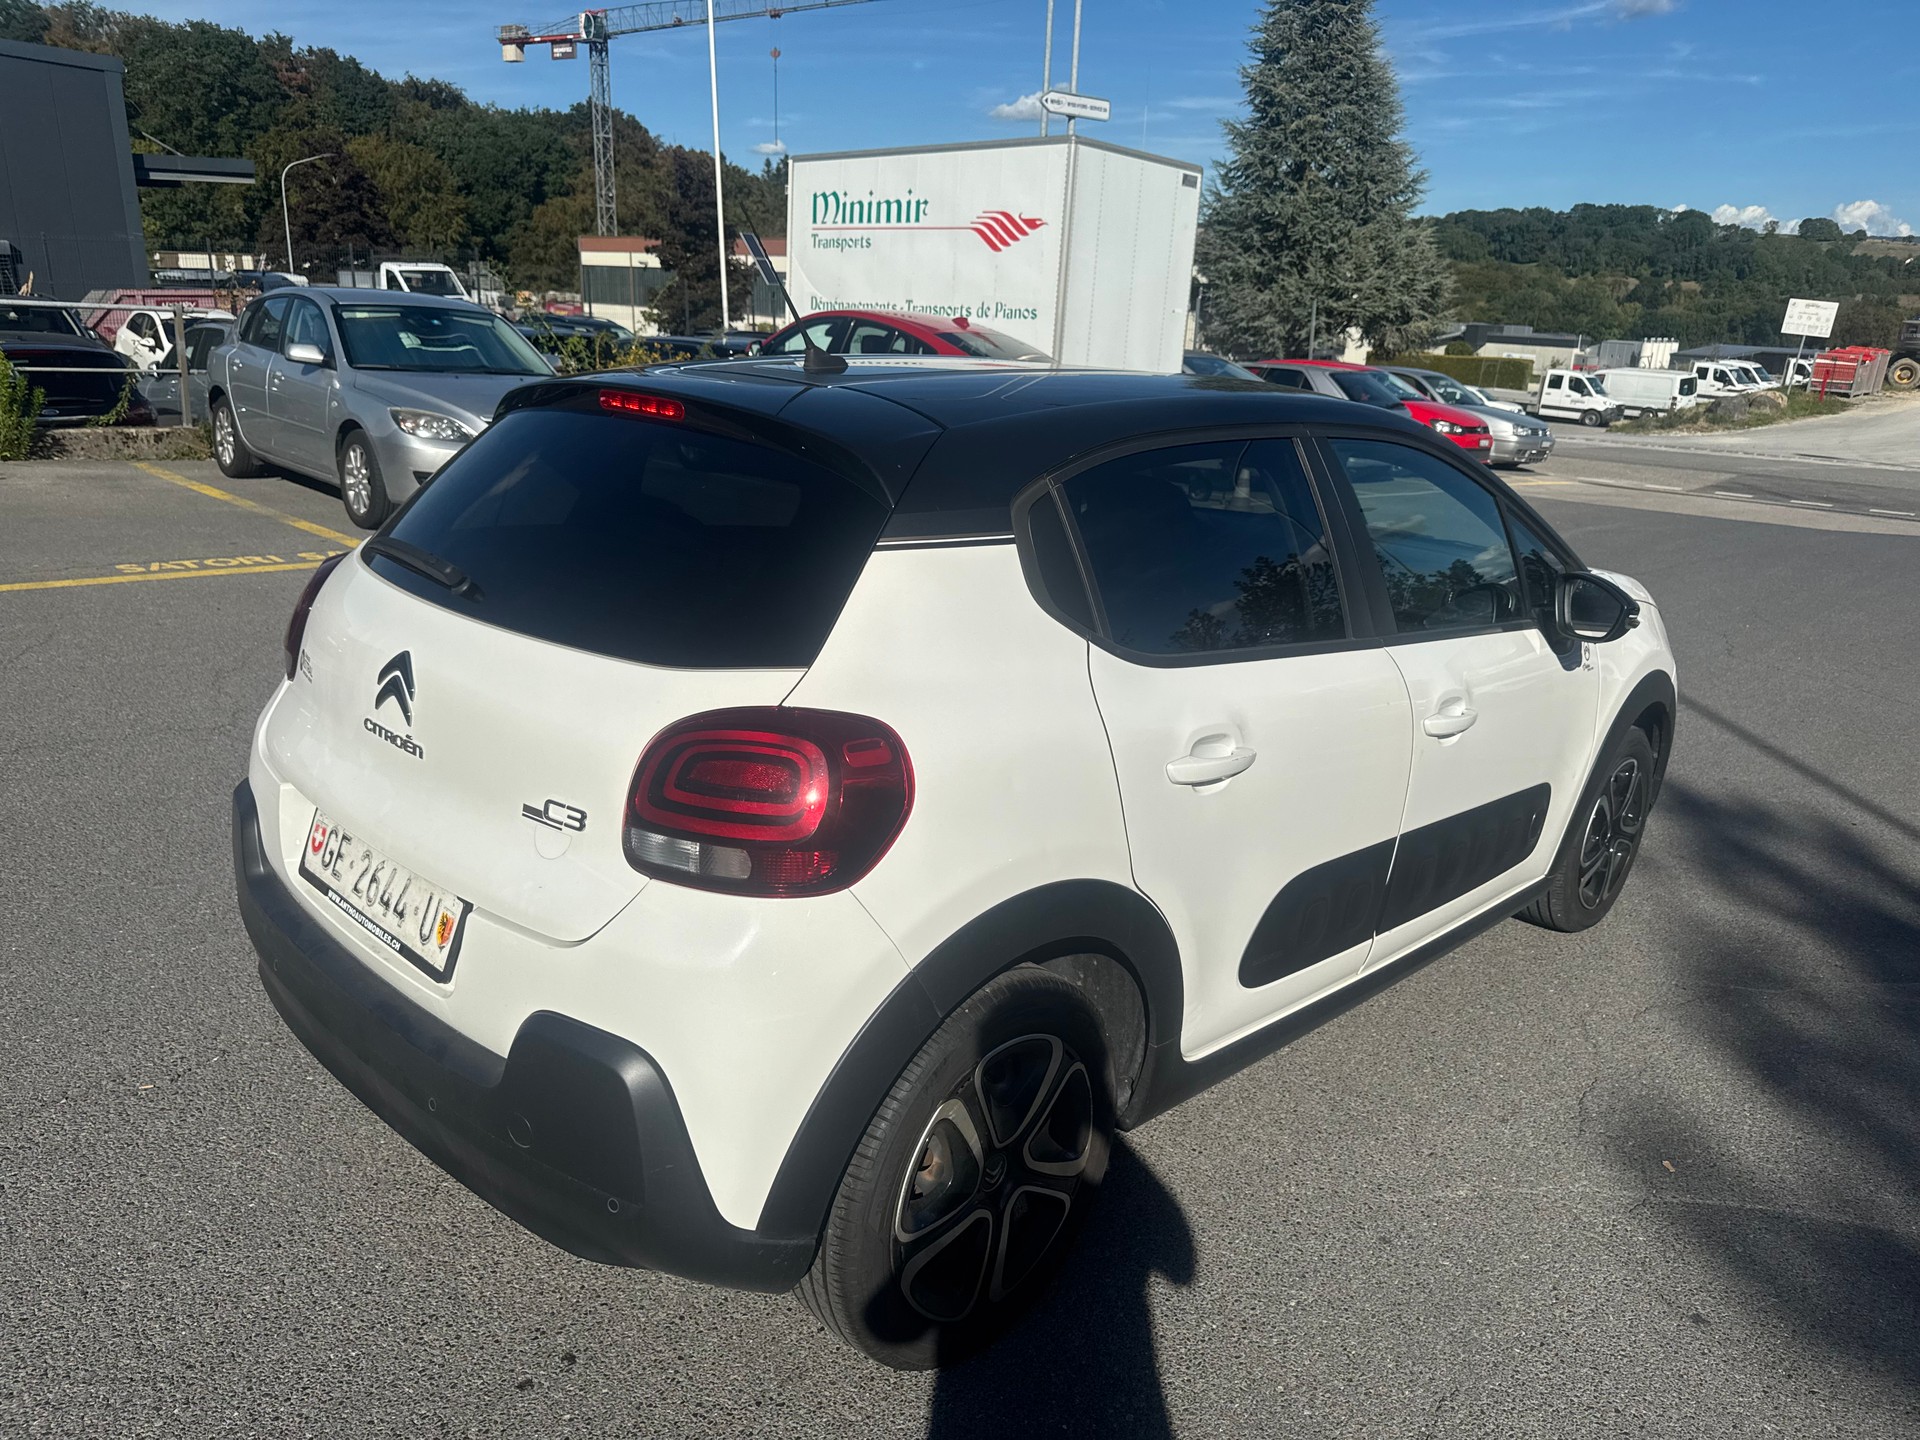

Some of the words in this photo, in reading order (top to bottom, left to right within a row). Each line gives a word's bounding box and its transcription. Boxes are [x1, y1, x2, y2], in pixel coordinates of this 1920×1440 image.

[812, 188, 929, 224] Minimir
[811, 233, 872, 253] Transports
[976, 301, 990, 318] de
[995, 302, 1037, 320] Pianos
[115, 555, 285, 574] SATORI
[363, 717, 424, 760] CITROËN
[543, 798, 588, 832] C3
[352, 849, 413, 928] 2644
